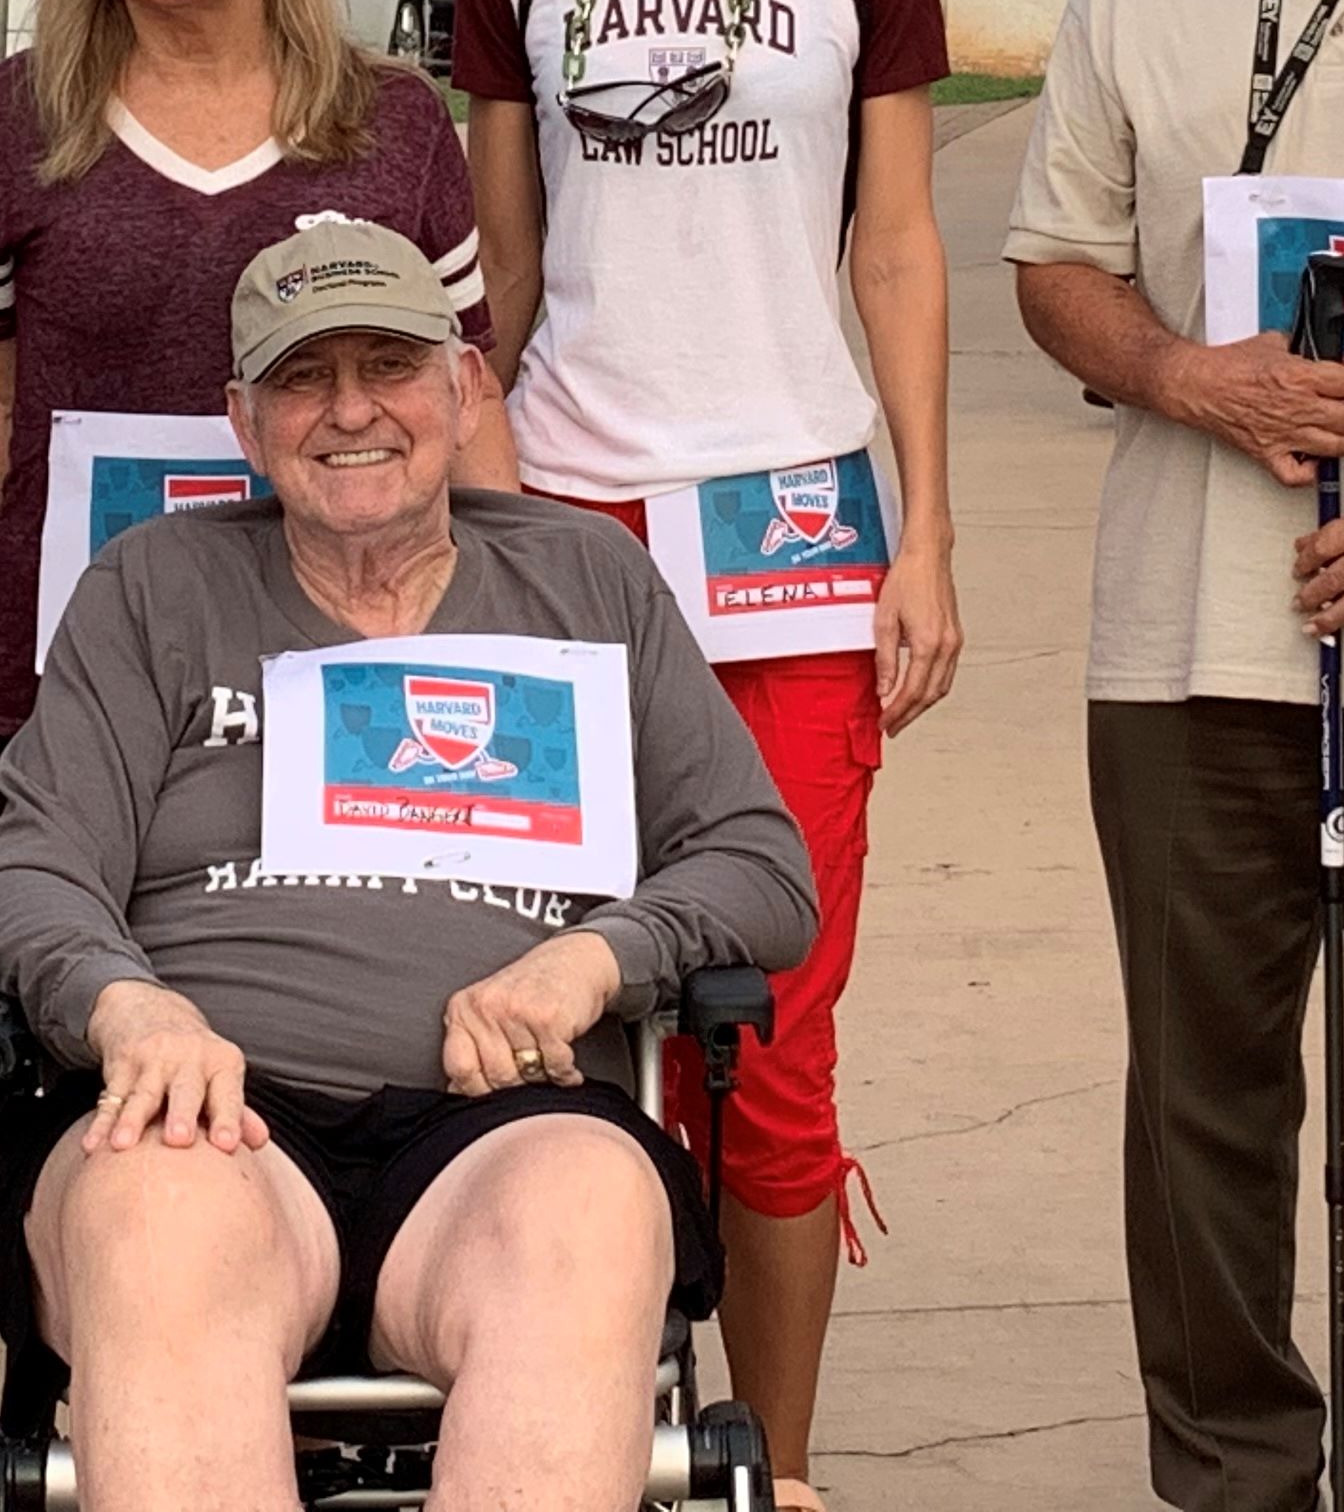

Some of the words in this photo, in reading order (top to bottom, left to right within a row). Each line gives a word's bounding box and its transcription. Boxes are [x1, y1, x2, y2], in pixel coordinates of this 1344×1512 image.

[1254, 106, 1279, 136] EY
[656, 118, 779, 167] SCHOOL
[777, 469, 829, 488] HARVARD
[791, 493, 829, 508] MOVES
[723, 583, 819, 609] ELENA
[416, 700, 481, 717] HARVARD
[430, 718, 479, 740] MOVES
